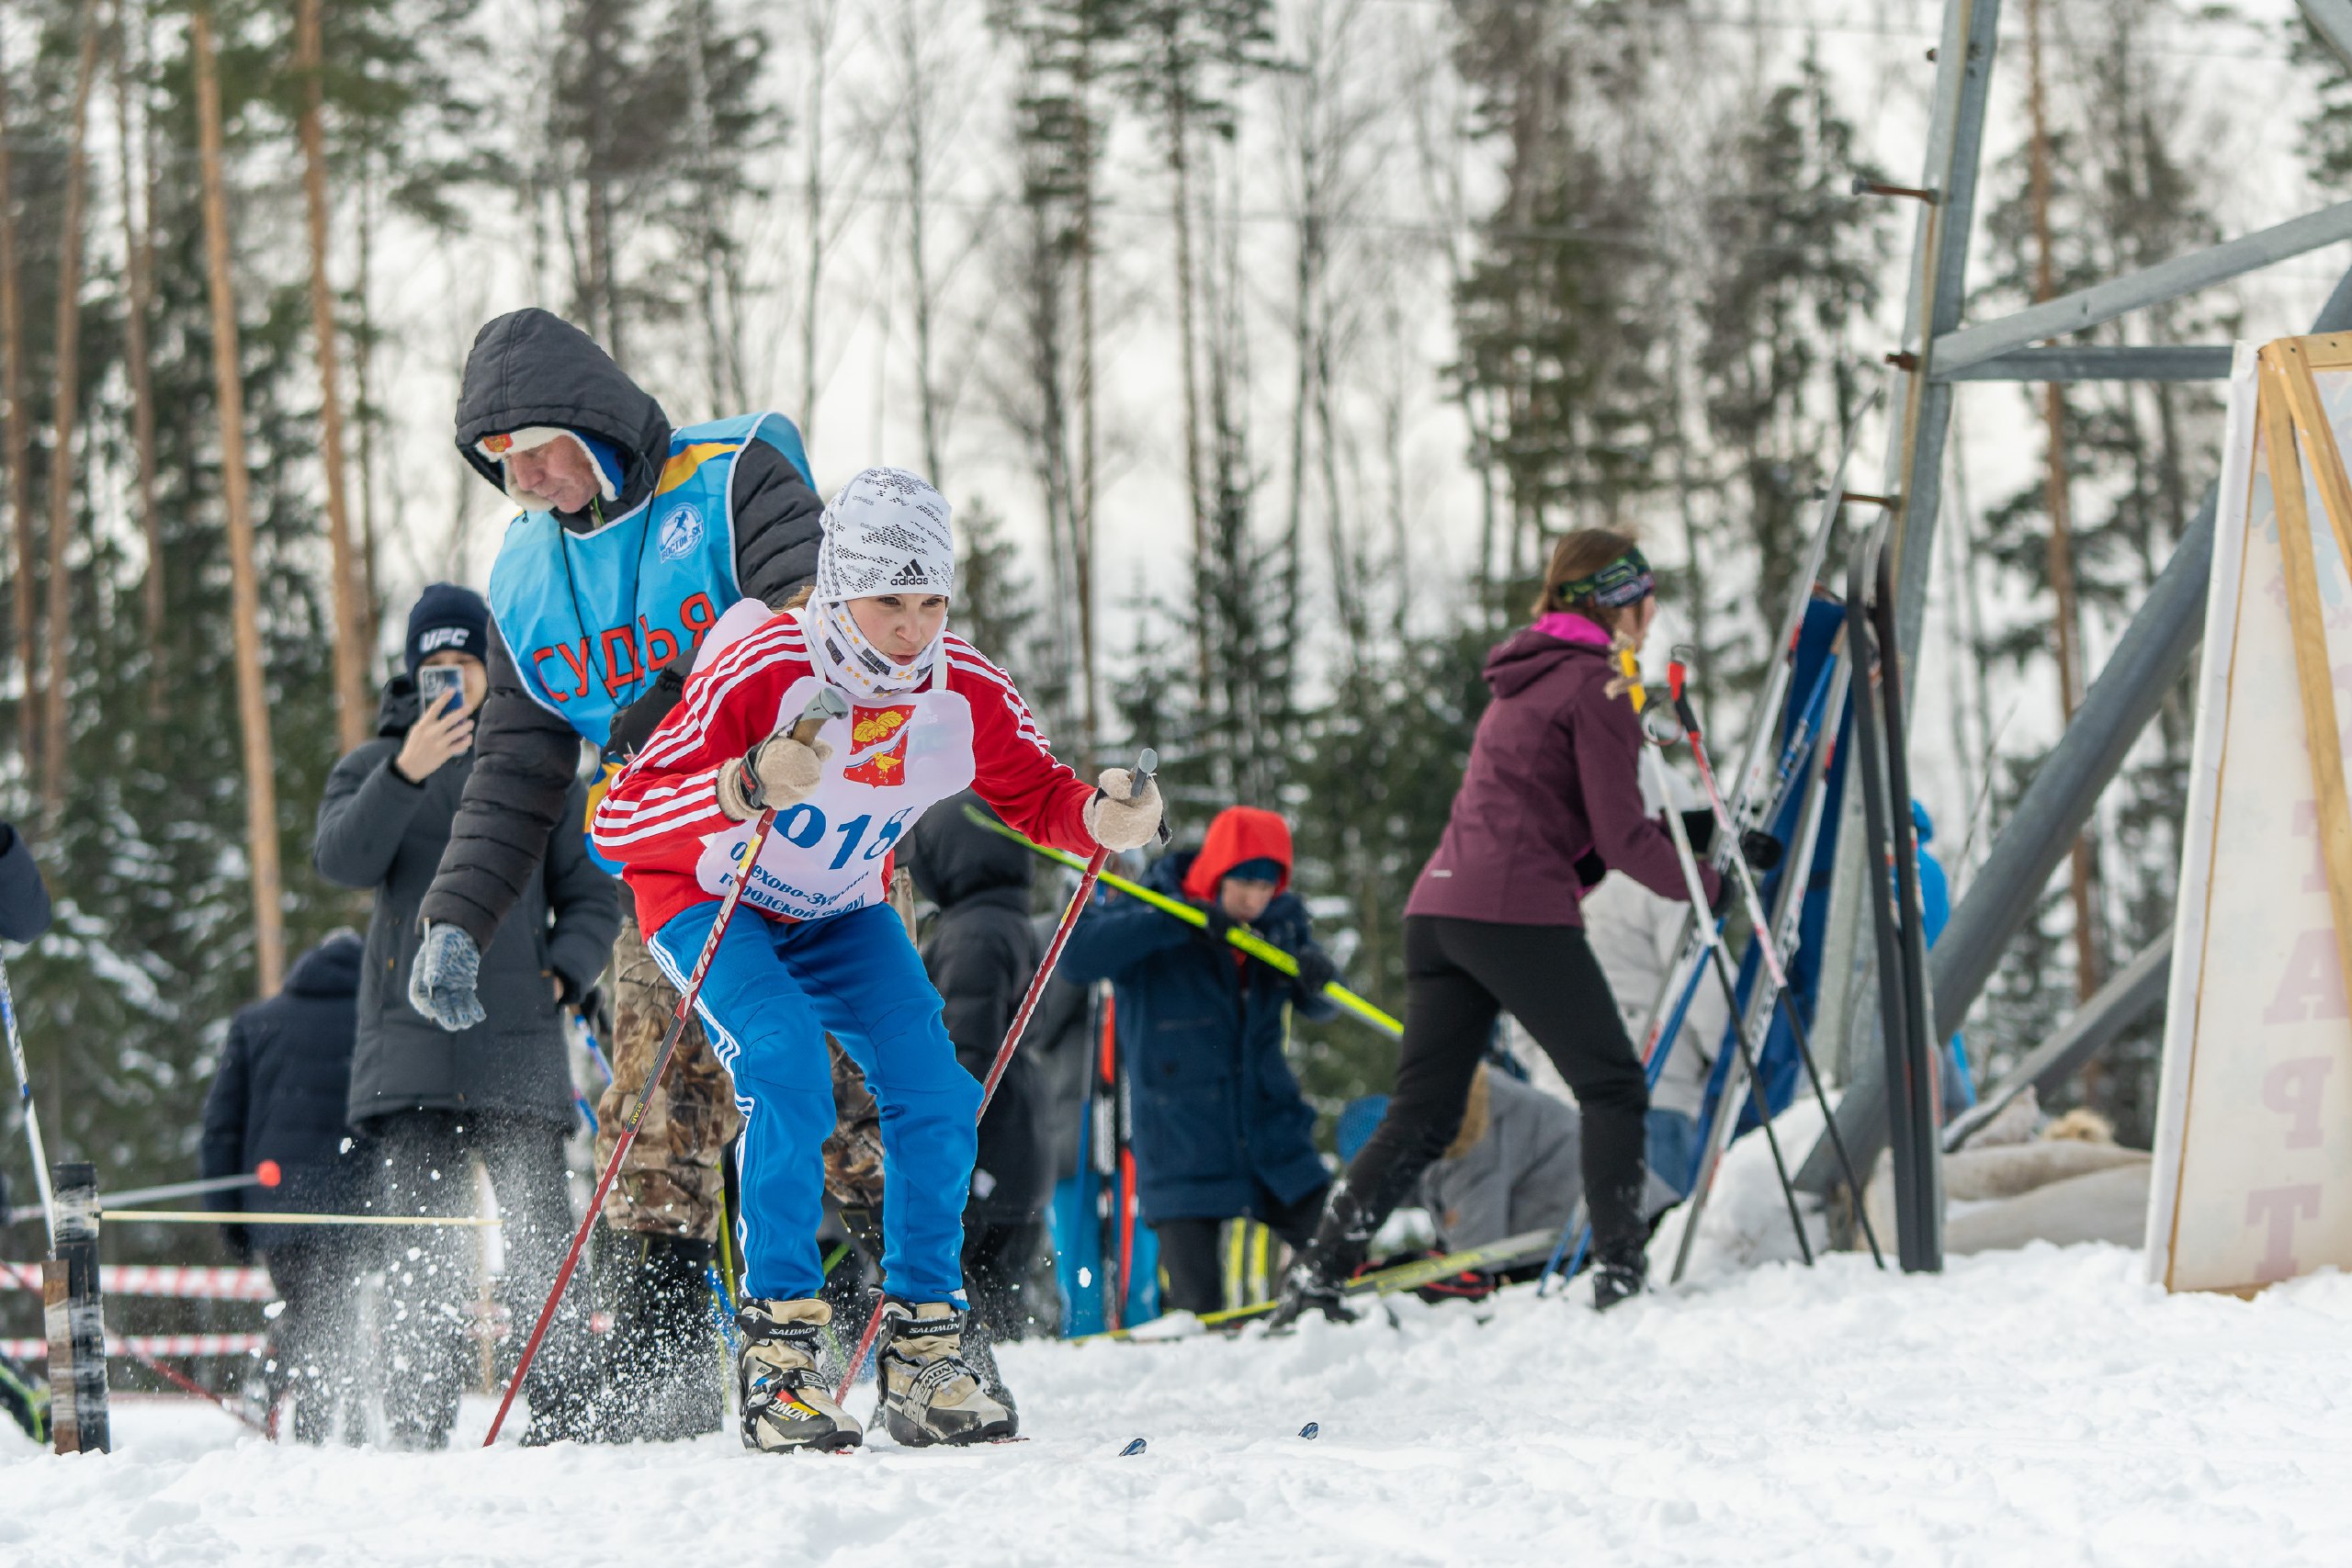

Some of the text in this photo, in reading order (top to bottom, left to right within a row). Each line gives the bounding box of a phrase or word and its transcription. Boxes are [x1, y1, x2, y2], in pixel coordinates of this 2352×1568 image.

[890, 575, 928, 586] adidas
[420, 627, 469, 653] UFC
[532, 592, 718, 703] СУДЬЯ
[773, 802, 914, 870] 018
[729, 840, 869, 908] Оехово-Зу
[719, 872, 818, 918] годской
[631, 1101, 644, 1126] STAR
[769, 1326, 817, 1336] SALOMON
[909, 1323, 960, 1334] SALOMON
